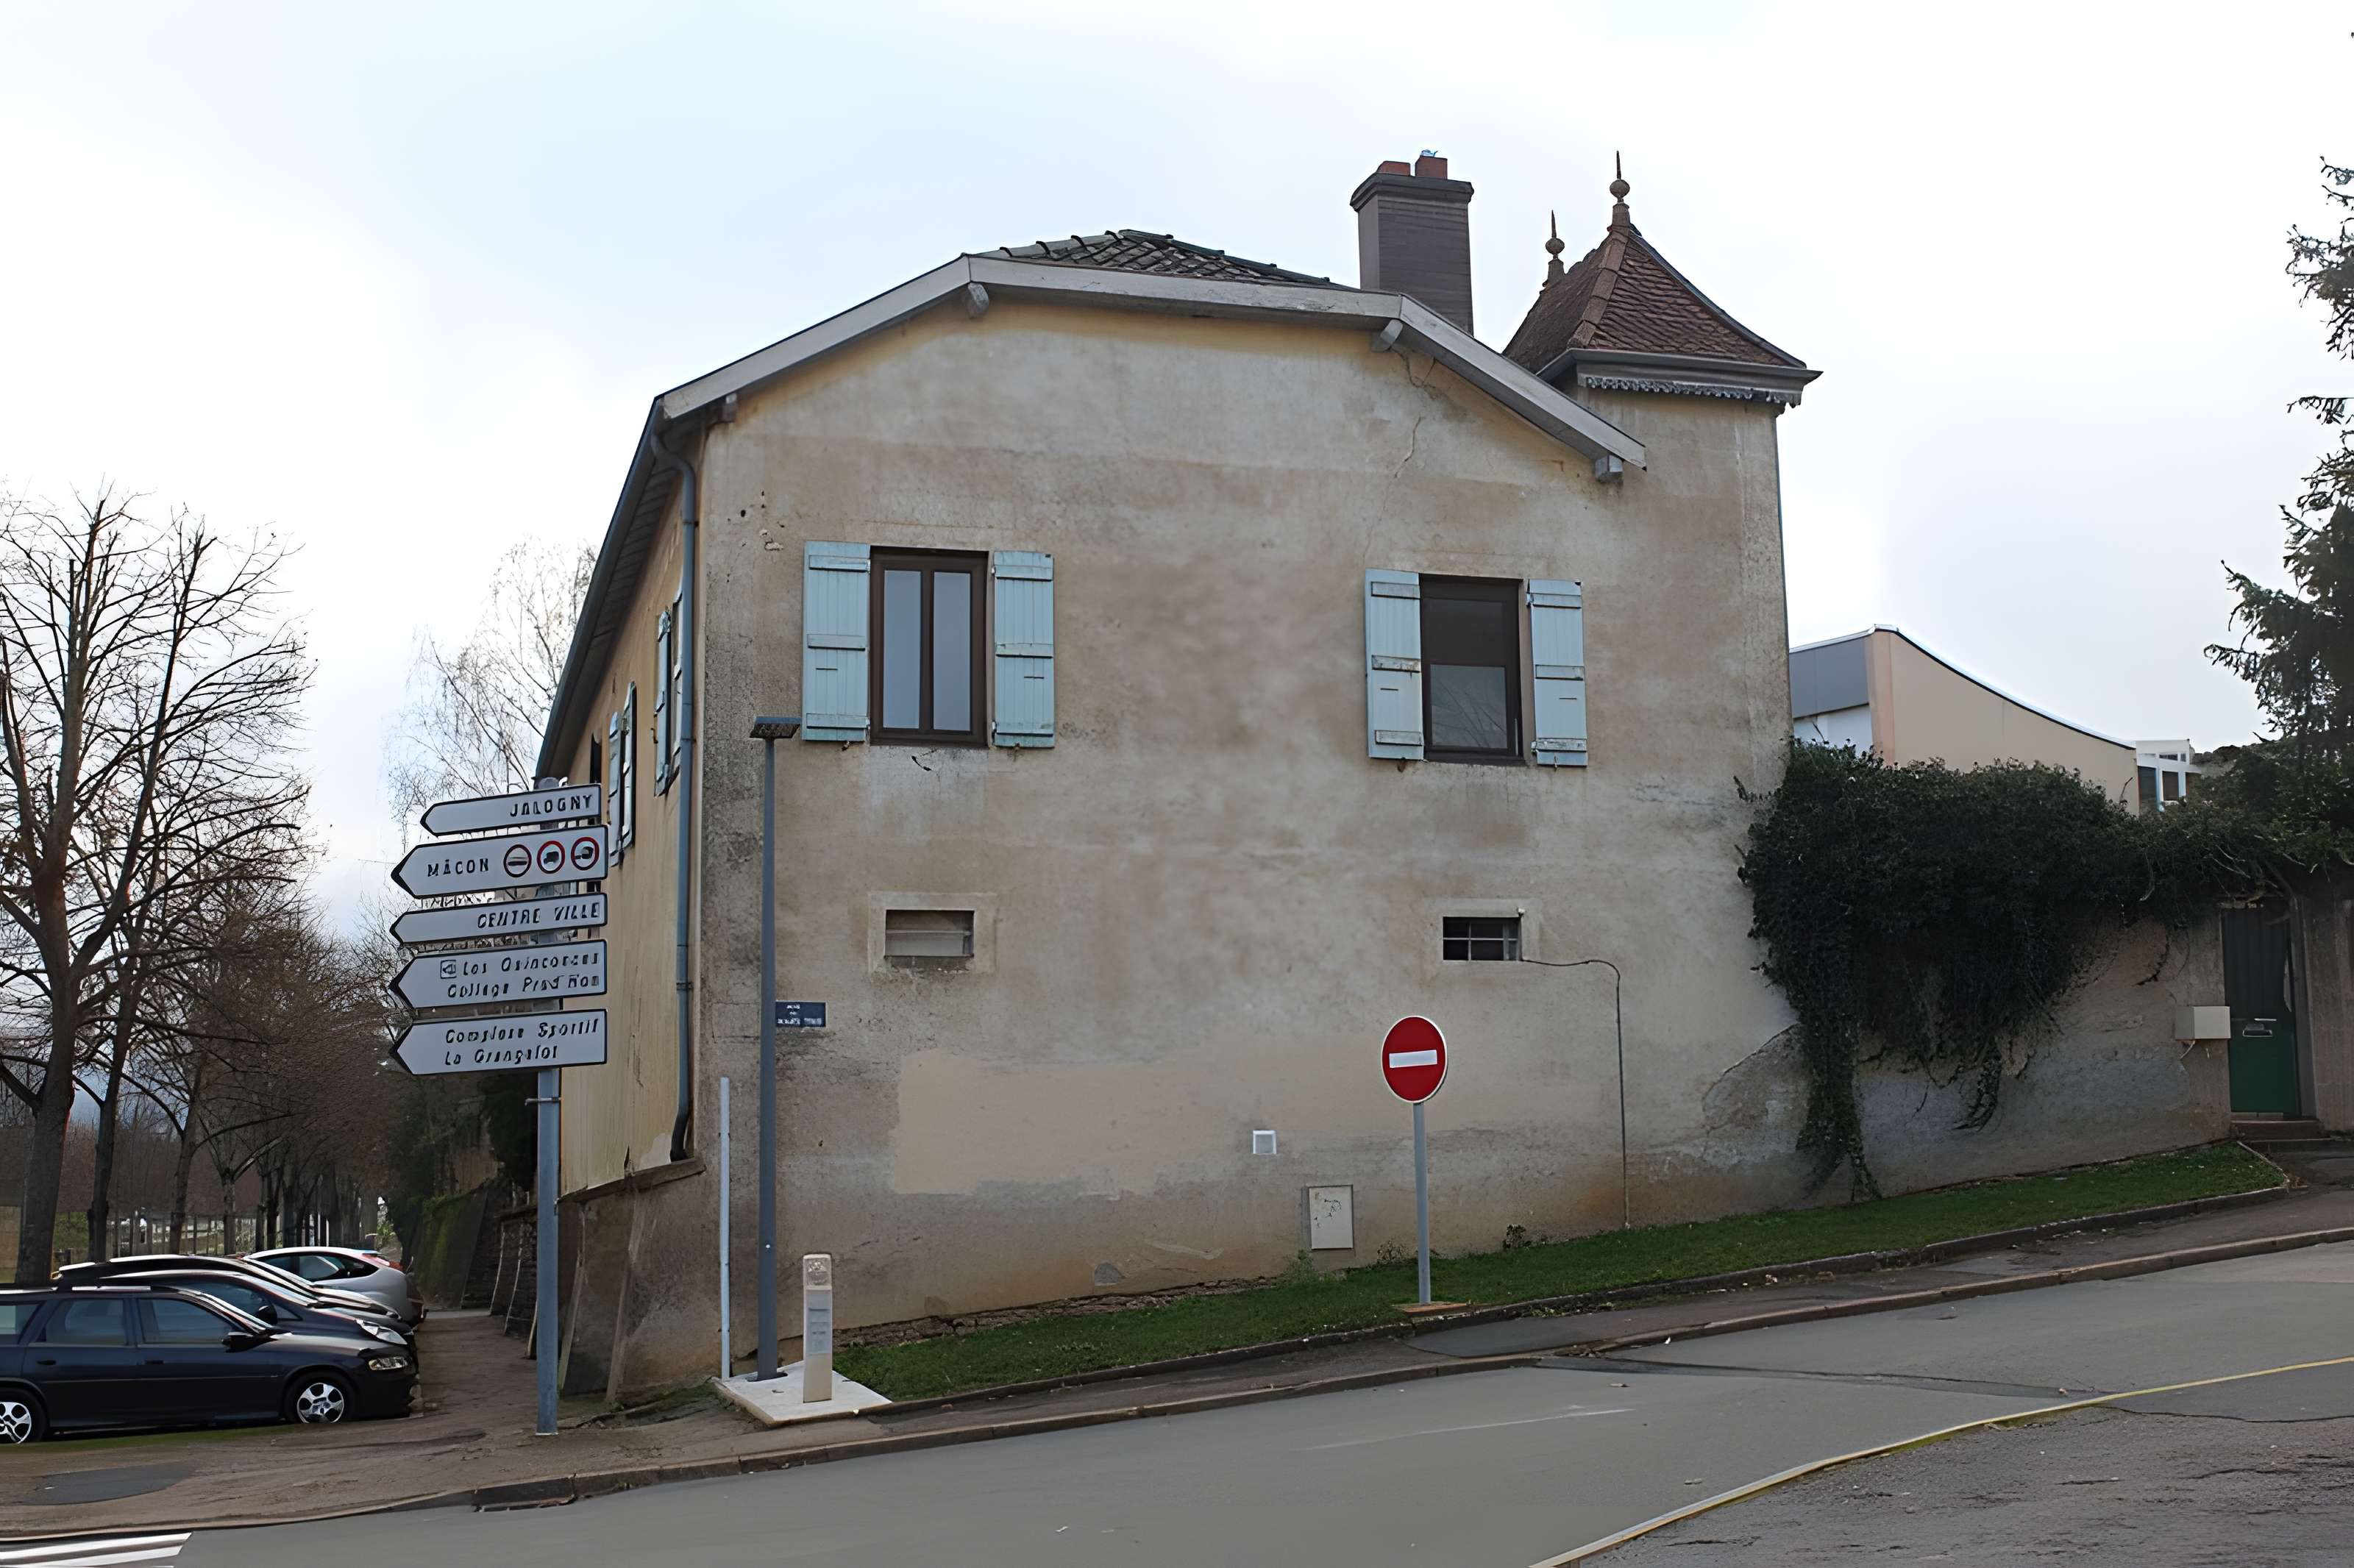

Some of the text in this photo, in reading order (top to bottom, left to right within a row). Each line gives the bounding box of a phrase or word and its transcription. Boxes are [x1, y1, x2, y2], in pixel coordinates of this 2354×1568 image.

[510, 794, 593, 817] JALOGNY
[478, 902, 600, 928] CENTRE VILLE
